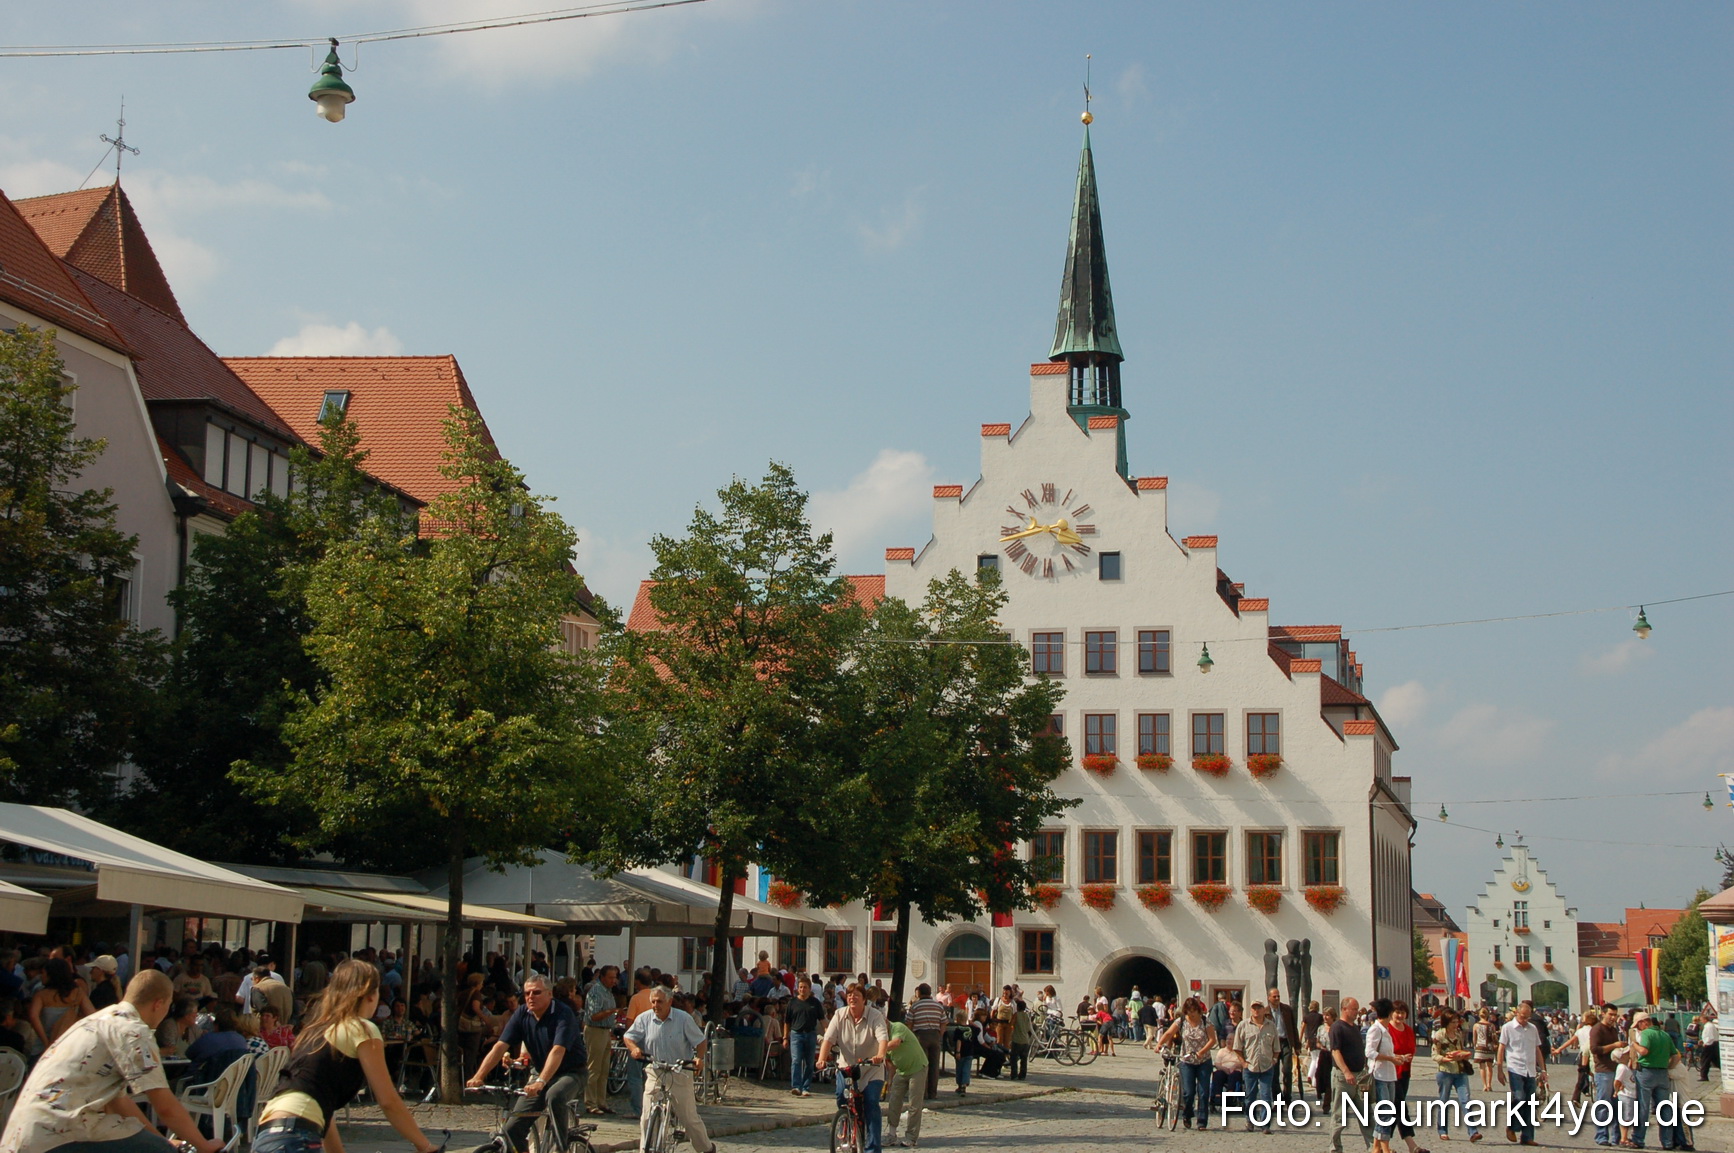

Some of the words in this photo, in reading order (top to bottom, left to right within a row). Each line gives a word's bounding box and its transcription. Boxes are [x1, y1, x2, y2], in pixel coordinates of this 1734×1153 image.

[1041, 483, 1055, 503] XII
[1061, 488, 1073, 506] I
[1006, 505, 1025, 521] X
[1071, 503, 1090, 518] II
[1076, 524, 1096, 534] III
[1061, 553, 1075, 572] V
